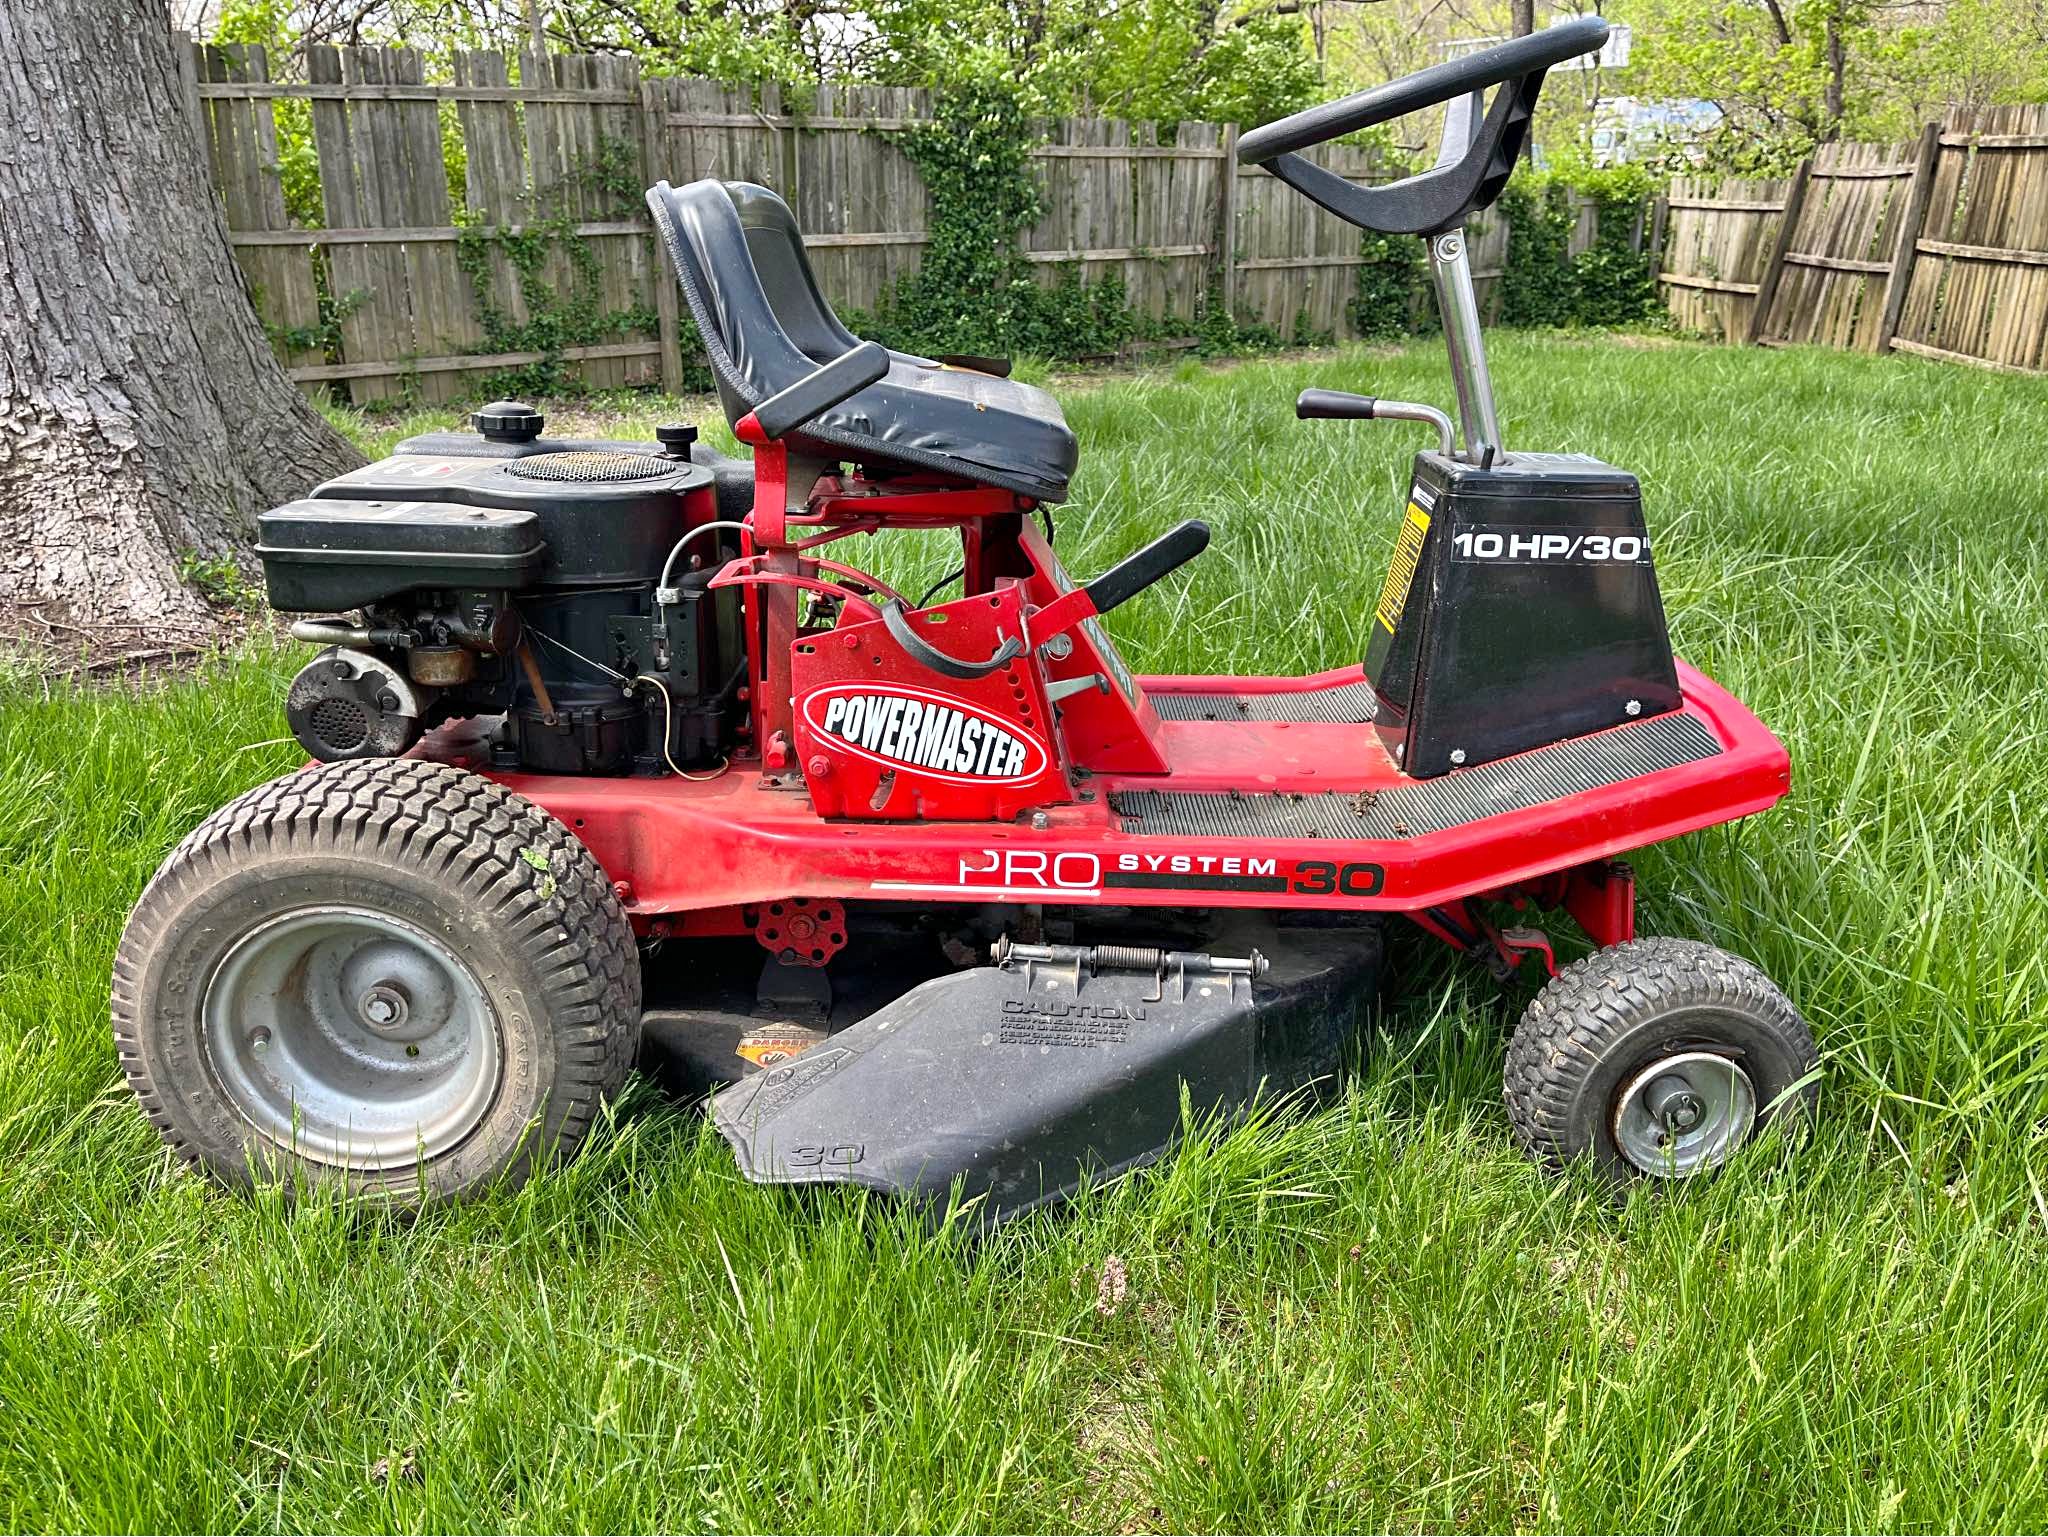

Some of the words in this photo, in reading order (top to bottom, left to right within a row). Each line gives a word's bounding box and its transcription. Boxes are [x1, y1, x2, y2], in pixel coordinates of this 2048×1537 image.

[1454, 533, 1503, 557] 10
[824, 695, 1027, 776] POWERMASTER
[959, 850, 1100, 887] PRO
[1119, 854, 1276, 875] SYSTEM
[1294, 861, 1385, 897] 30
[1001, 1000, 1146, 1020] CAUTION
[789, 1144, 865, 1166] 30
